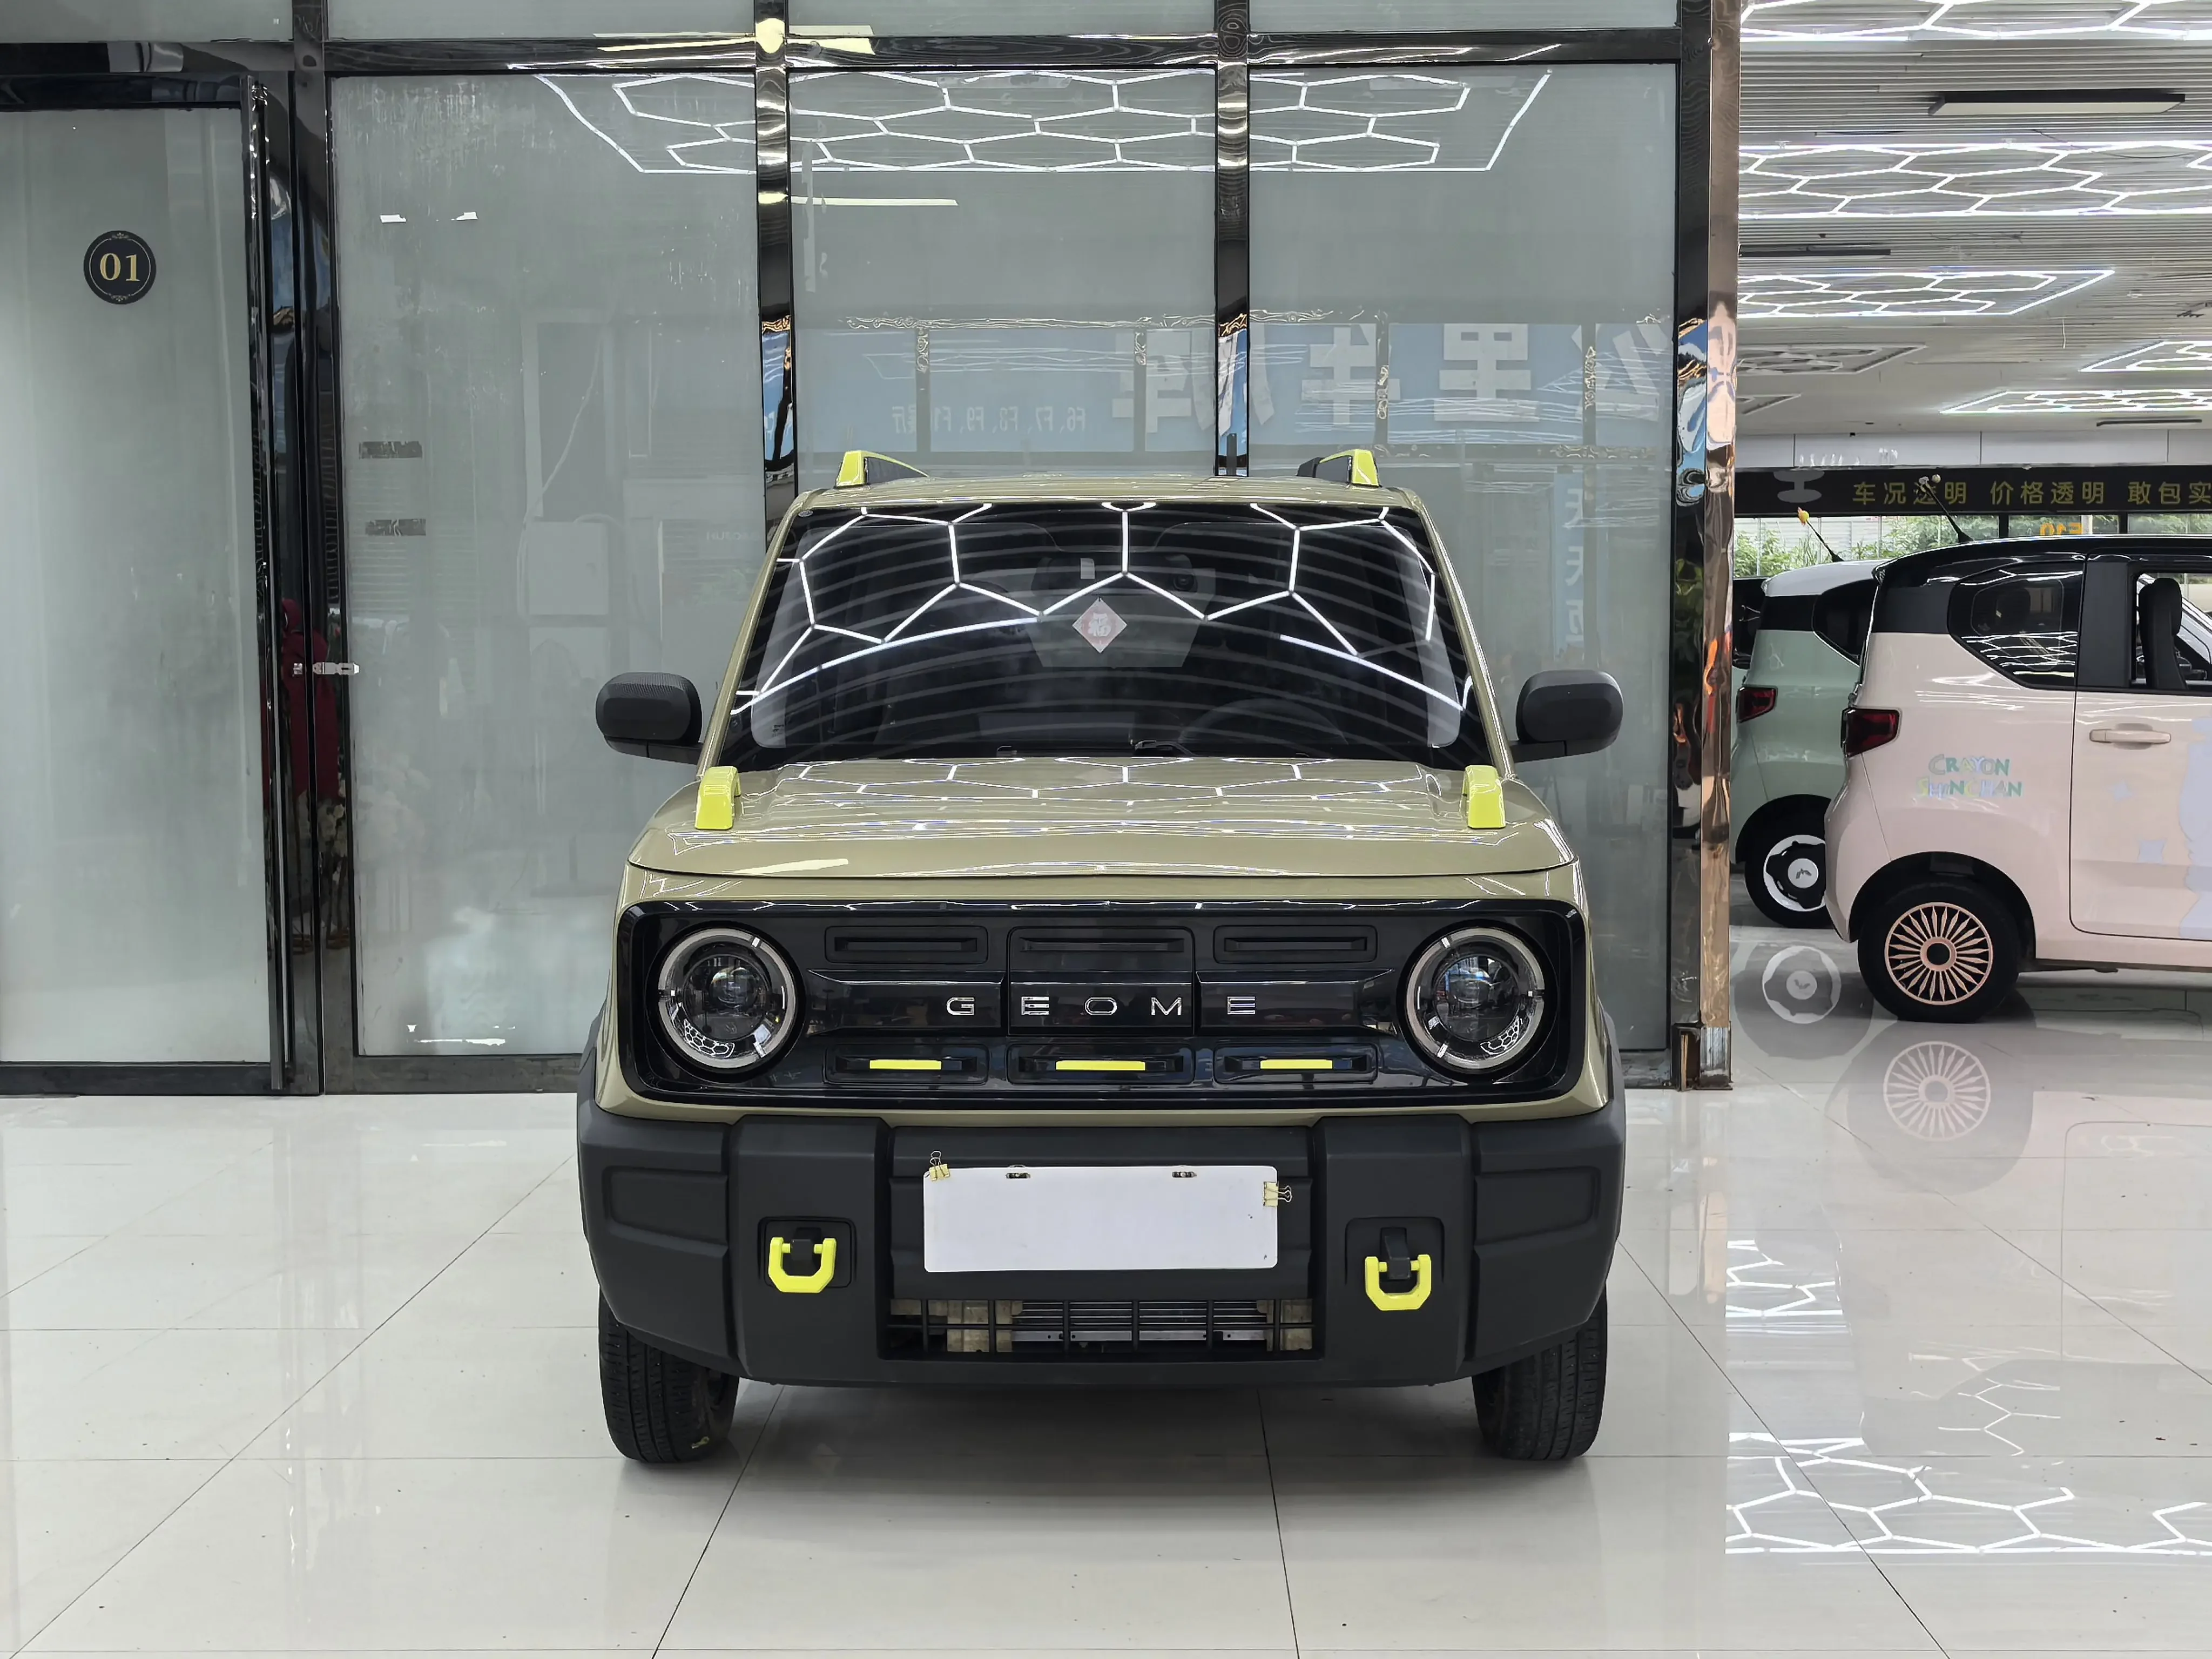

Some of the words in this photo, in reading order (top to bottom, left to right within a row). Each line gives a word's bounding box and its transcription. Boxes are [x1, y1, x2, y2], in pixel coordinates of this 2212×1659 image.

[99, 253, 140, 282] 01
[1990, 480, 2105, 505] 价格透明
[2128, 480, 2212, 505] 敢包实
[1928, 753, 2011, 777] CRAYON
[1916, 775, 2023, 798] SHINCHAN
[946, 996, 1256, 1016] GEOME
